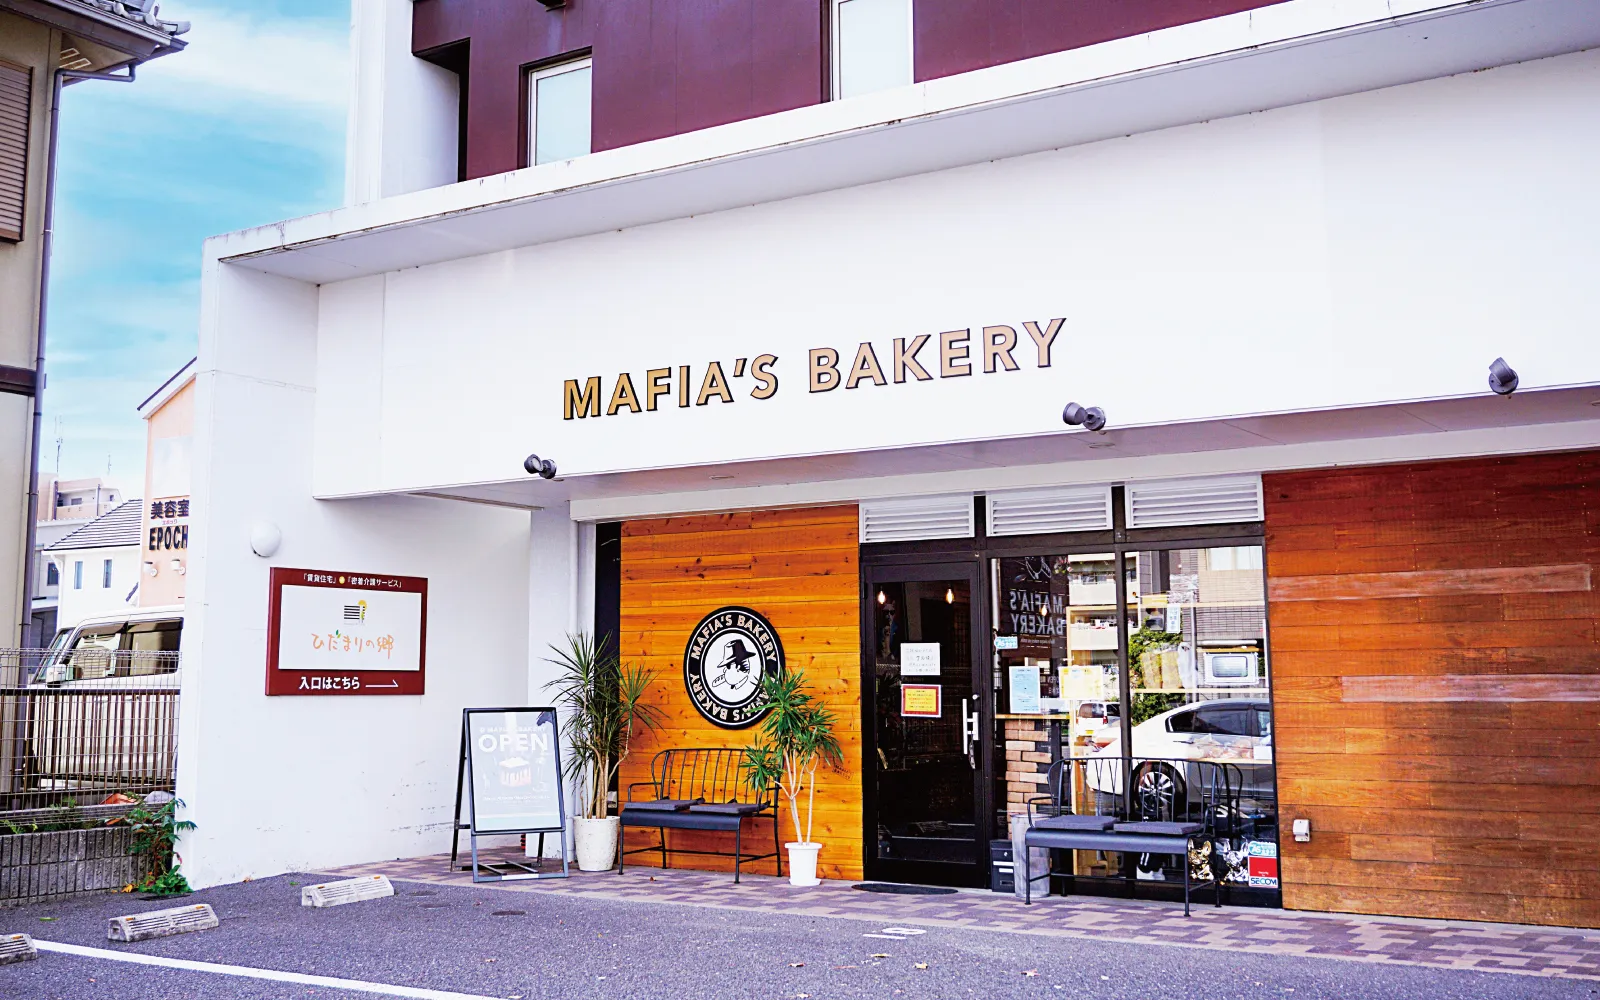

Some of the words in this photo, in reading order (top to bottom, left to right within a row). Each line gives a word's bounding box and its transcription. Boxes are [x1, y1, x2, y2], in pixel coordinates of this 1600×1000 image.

[563, 353, 779, 420] MAFIA'S
[807, 317, 1067, 393] BAKERY
[150, 499, 190, 520] 美容室
[148, 524, 189, 551] EPOCH
[311, 630, 394, 660] ひだまりの郷
[690, 614, 733, 660] MAFIA'S
[736, 614, 777, 662] BAKERY
[299, 676, 361, 690] 入口はこちら
[690, 673, 728, 721] BAKERY
[478, 733, 549, 753] OPEN
[1250, 877, 1277, 886] SECOM
